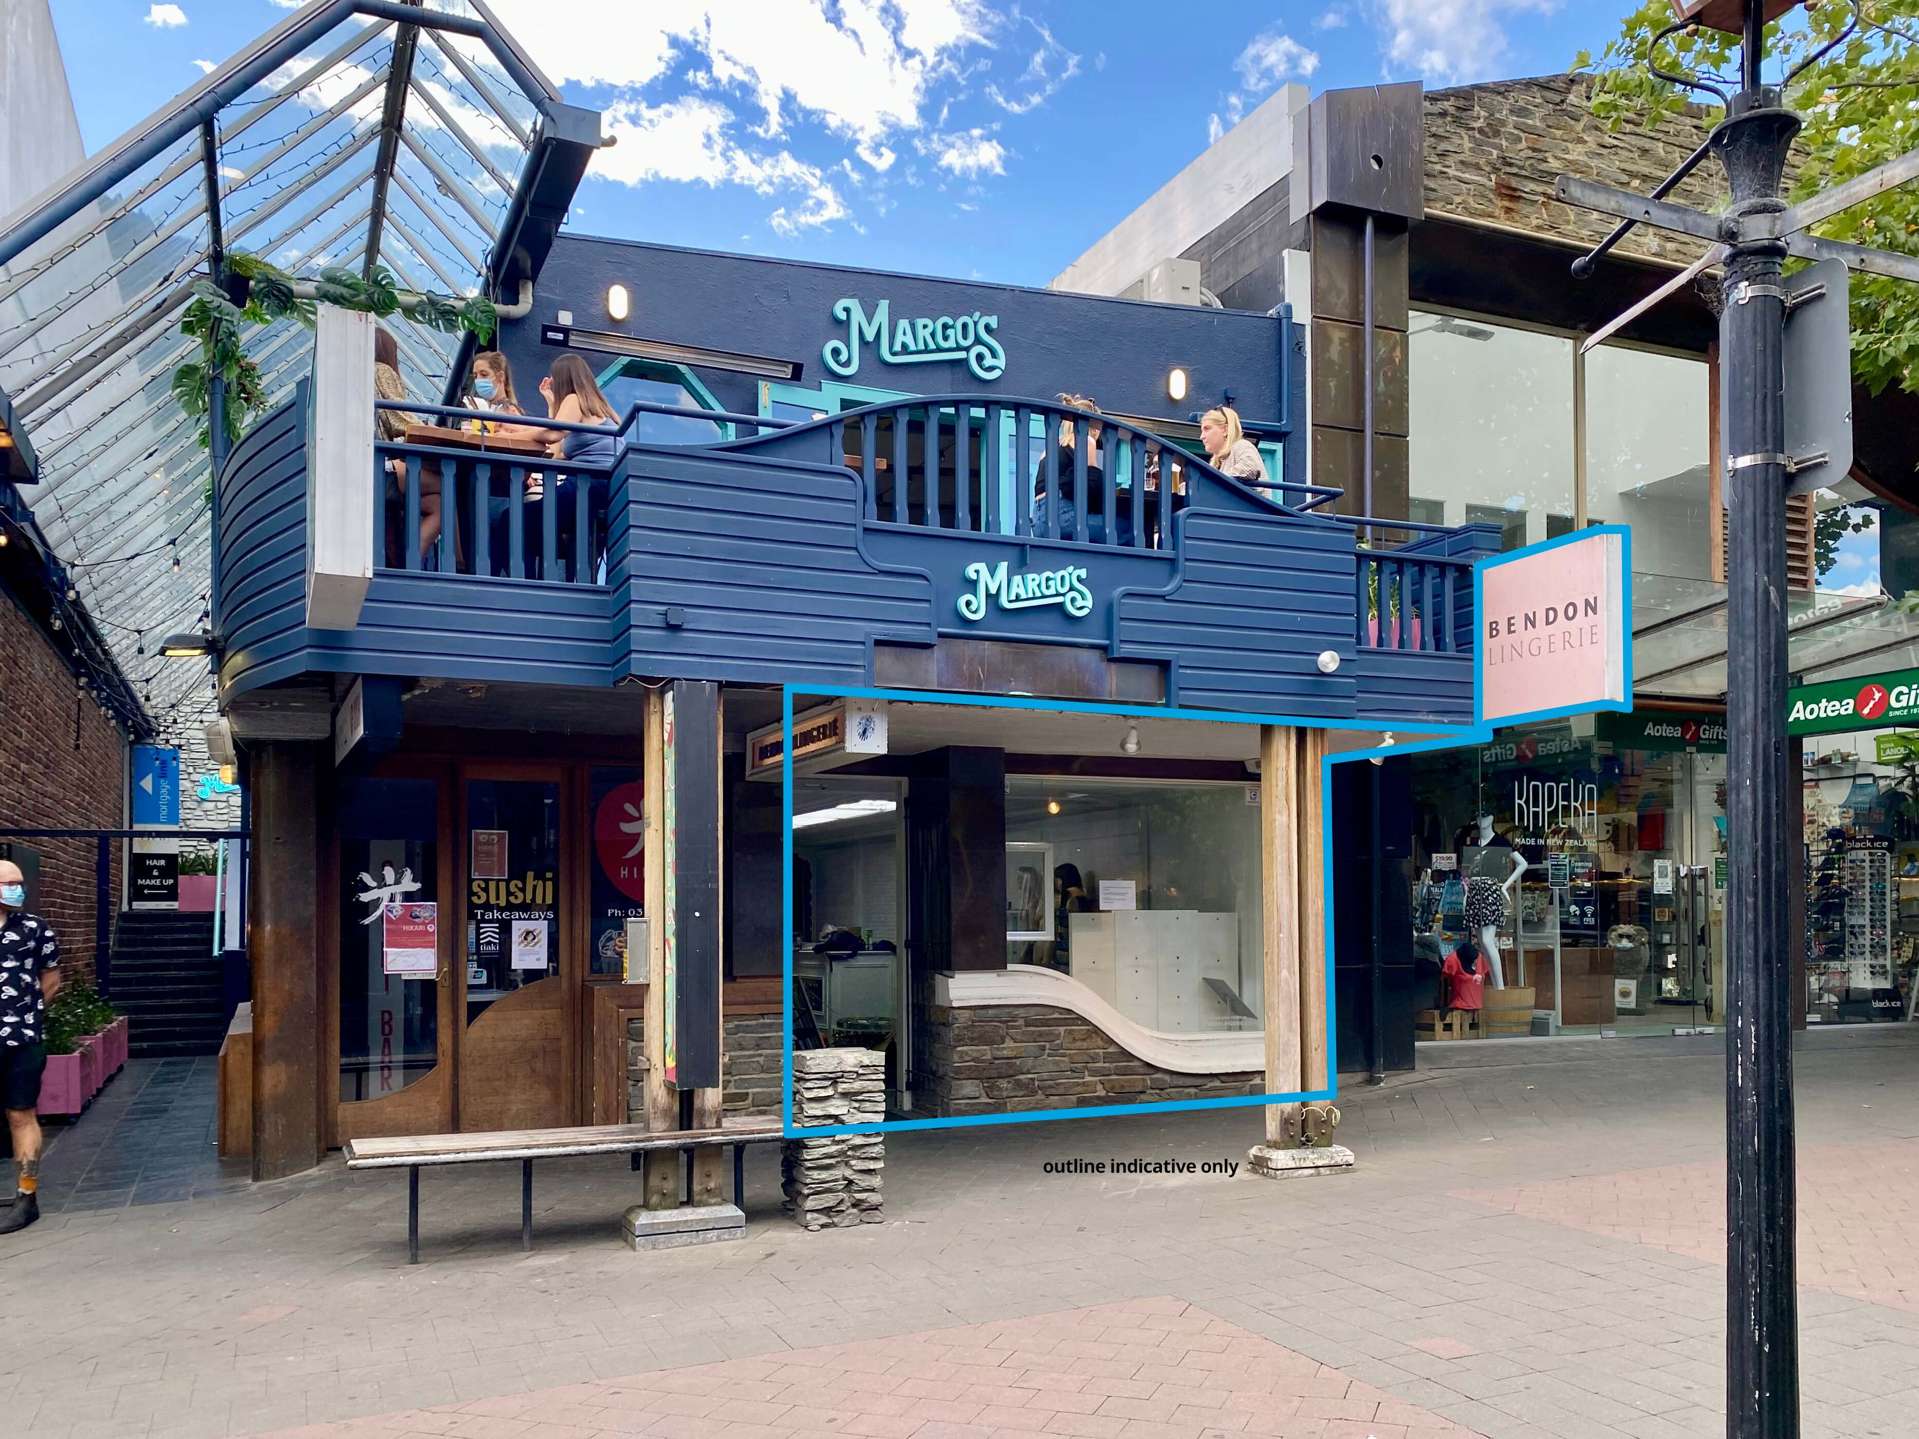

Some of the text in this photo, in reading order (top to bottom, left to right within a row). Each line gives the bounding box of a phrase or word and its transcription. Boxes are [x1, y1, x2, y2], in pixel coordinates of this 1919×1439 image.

[1488, 596, 1598, 640] BENDON
[1488, 624, 1599, 666] LINGERIE
[1788, 698, 1855, 722] Aotea
[1644, 721, 1682, 737] Aotea
[159, 779, 172, 822] mortgage
[1514, 775, 1597, 834] KAPEKA
[1537, 838, 1545, 846] IN
[1546, 838, 1562, 846] NEW
[1564, 839, 1598, 847] ZEALAND
[1845, 839, 1872, 849] black
[471, 871, 554, 906] sushi
[474, 909, 554, 921] Takeaways
[607, 908, 643, 917] Ph: 03
[380, 1009, 394, 1091] BAR
